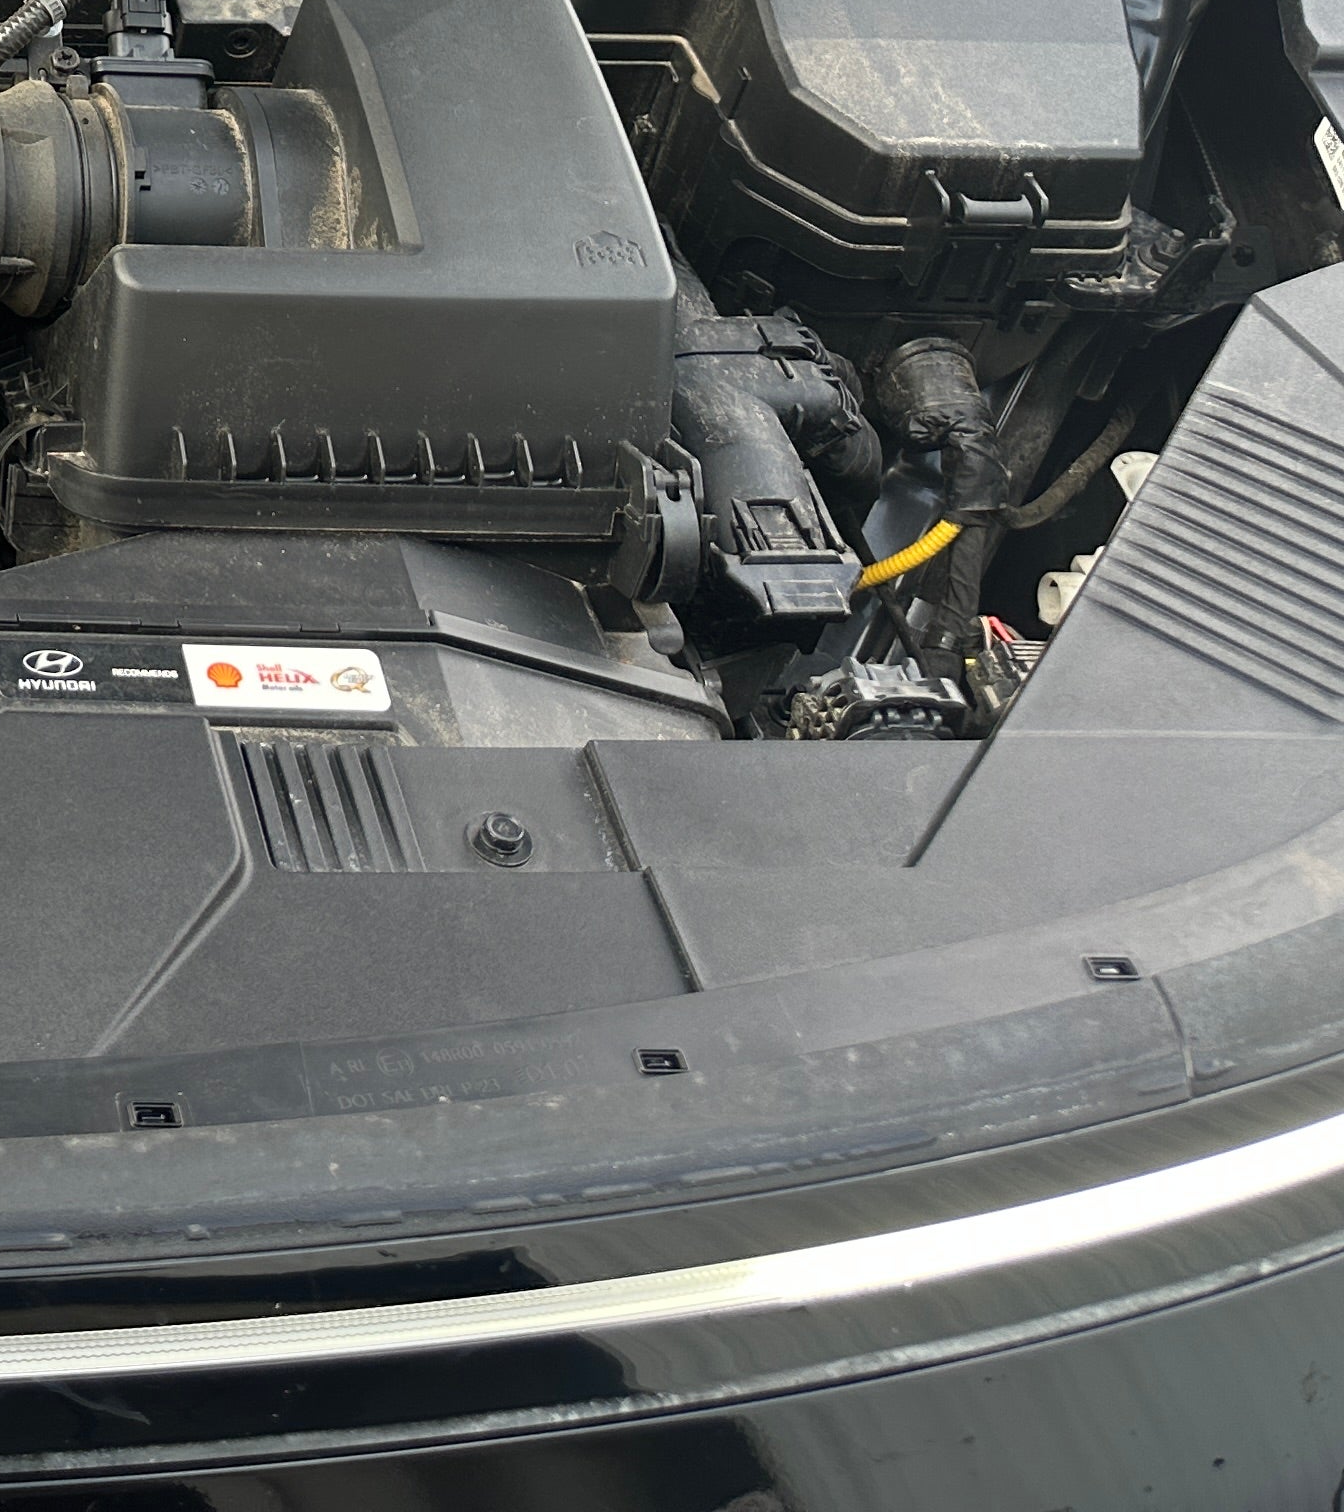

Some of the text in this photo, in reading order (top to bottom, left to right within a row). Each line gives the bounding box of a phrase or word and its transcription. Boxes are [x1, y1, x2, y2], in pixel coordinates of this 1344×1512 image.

[111, 667, 179, 679] RECOMMENDS
[256, 663, 282, 672] Shell
[259, 670, 320, 684] HELIX
[18, 678, 97, 692] HYUNDAI
